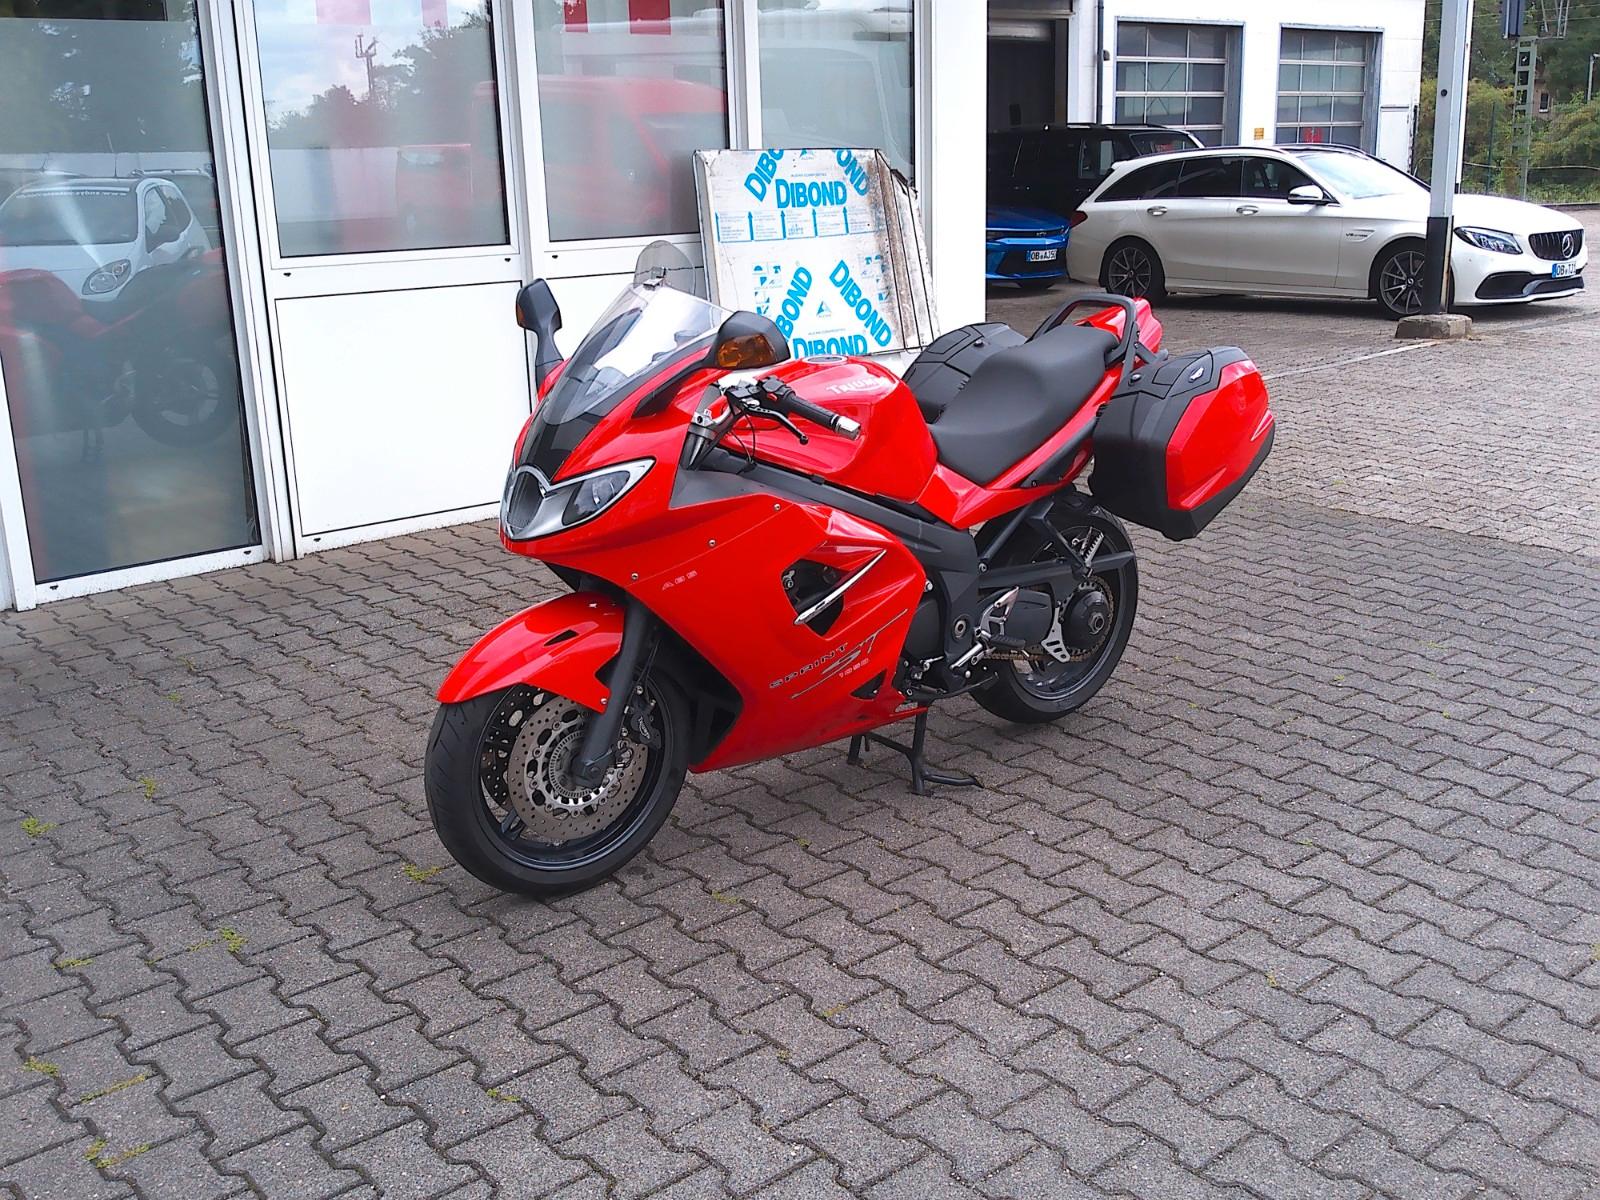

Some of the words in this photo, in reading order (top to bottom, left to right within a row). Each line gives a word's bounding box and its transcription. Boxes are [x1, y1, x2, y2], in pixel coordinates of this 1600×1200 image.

[744, 148, 785, 203] DIBO
[775, 178, 848, 209] DIBOND
[834, 148, 869, 197] OND
[776, 266, 813, 342] BOND
[829, 259, 892, 347] DIBOND
[793, 334, 868, 360] DIBOND
[826, 376, 879, 395] TRIUM
[662, 570, 698, 591] ABS
[769, 641, 848, 689] SPRINT
